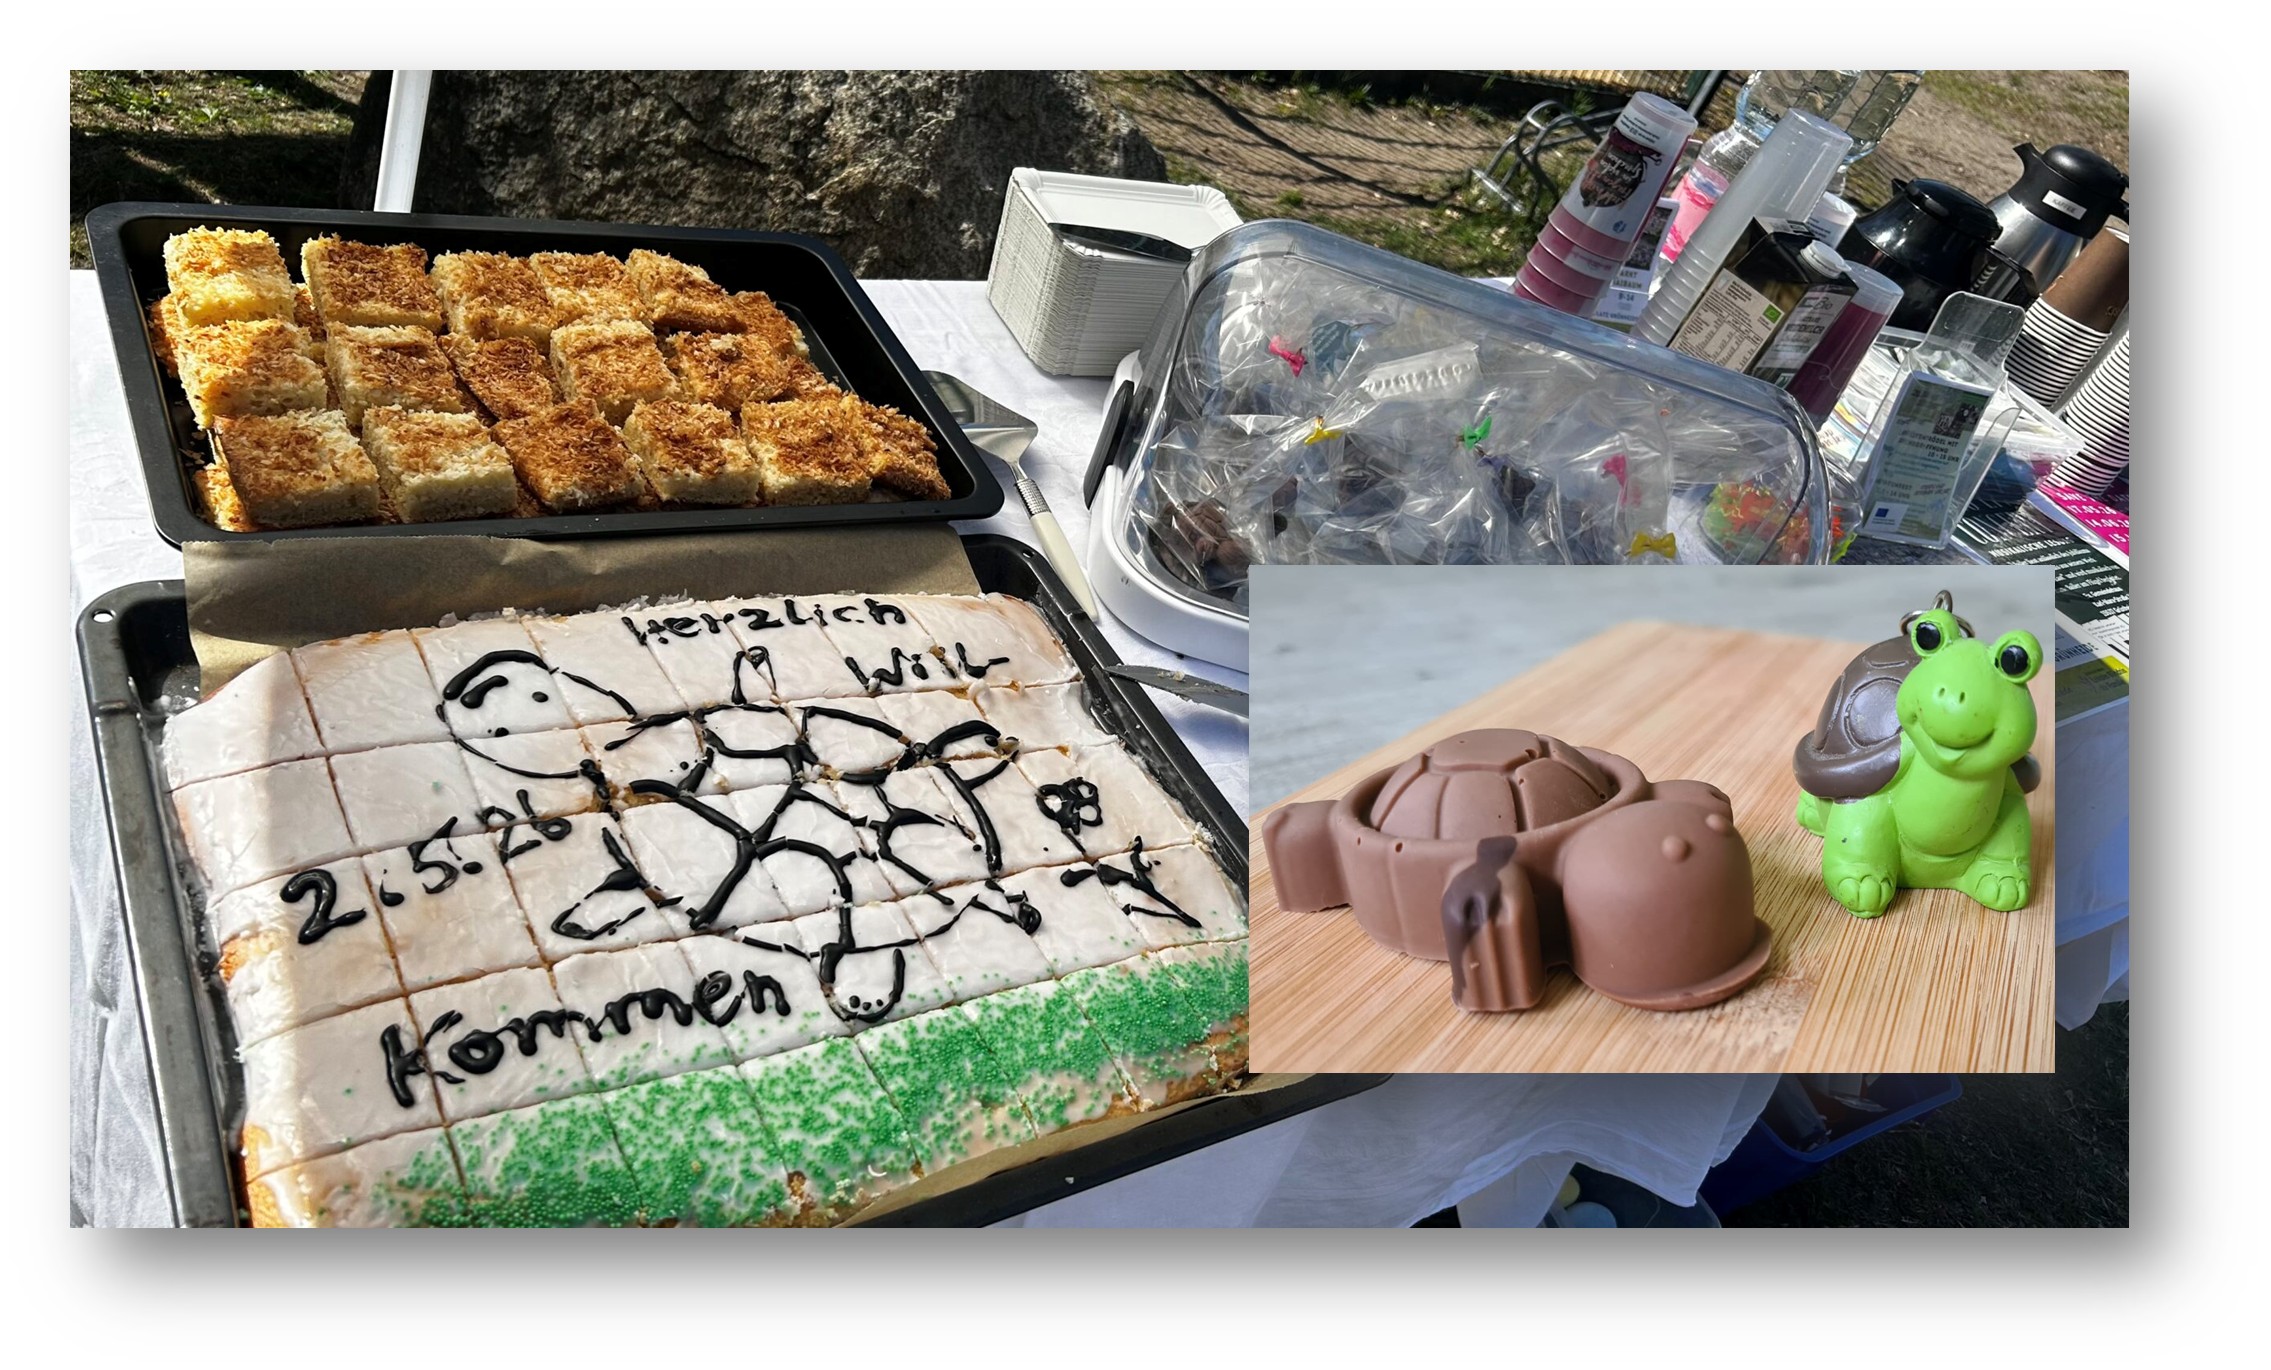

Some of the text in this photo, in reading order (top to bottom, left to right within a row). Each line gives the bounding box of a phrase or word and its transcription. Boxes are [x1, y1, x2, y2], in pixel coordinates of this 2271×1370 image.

[1620, 270, 1638, 278] ARKT
[2056, 492, 2087, 501] SAVE
[2067, 505, 2117, 514] 17.05.26
[1988, 541, 2047, 558] MUSIKALISCHE
